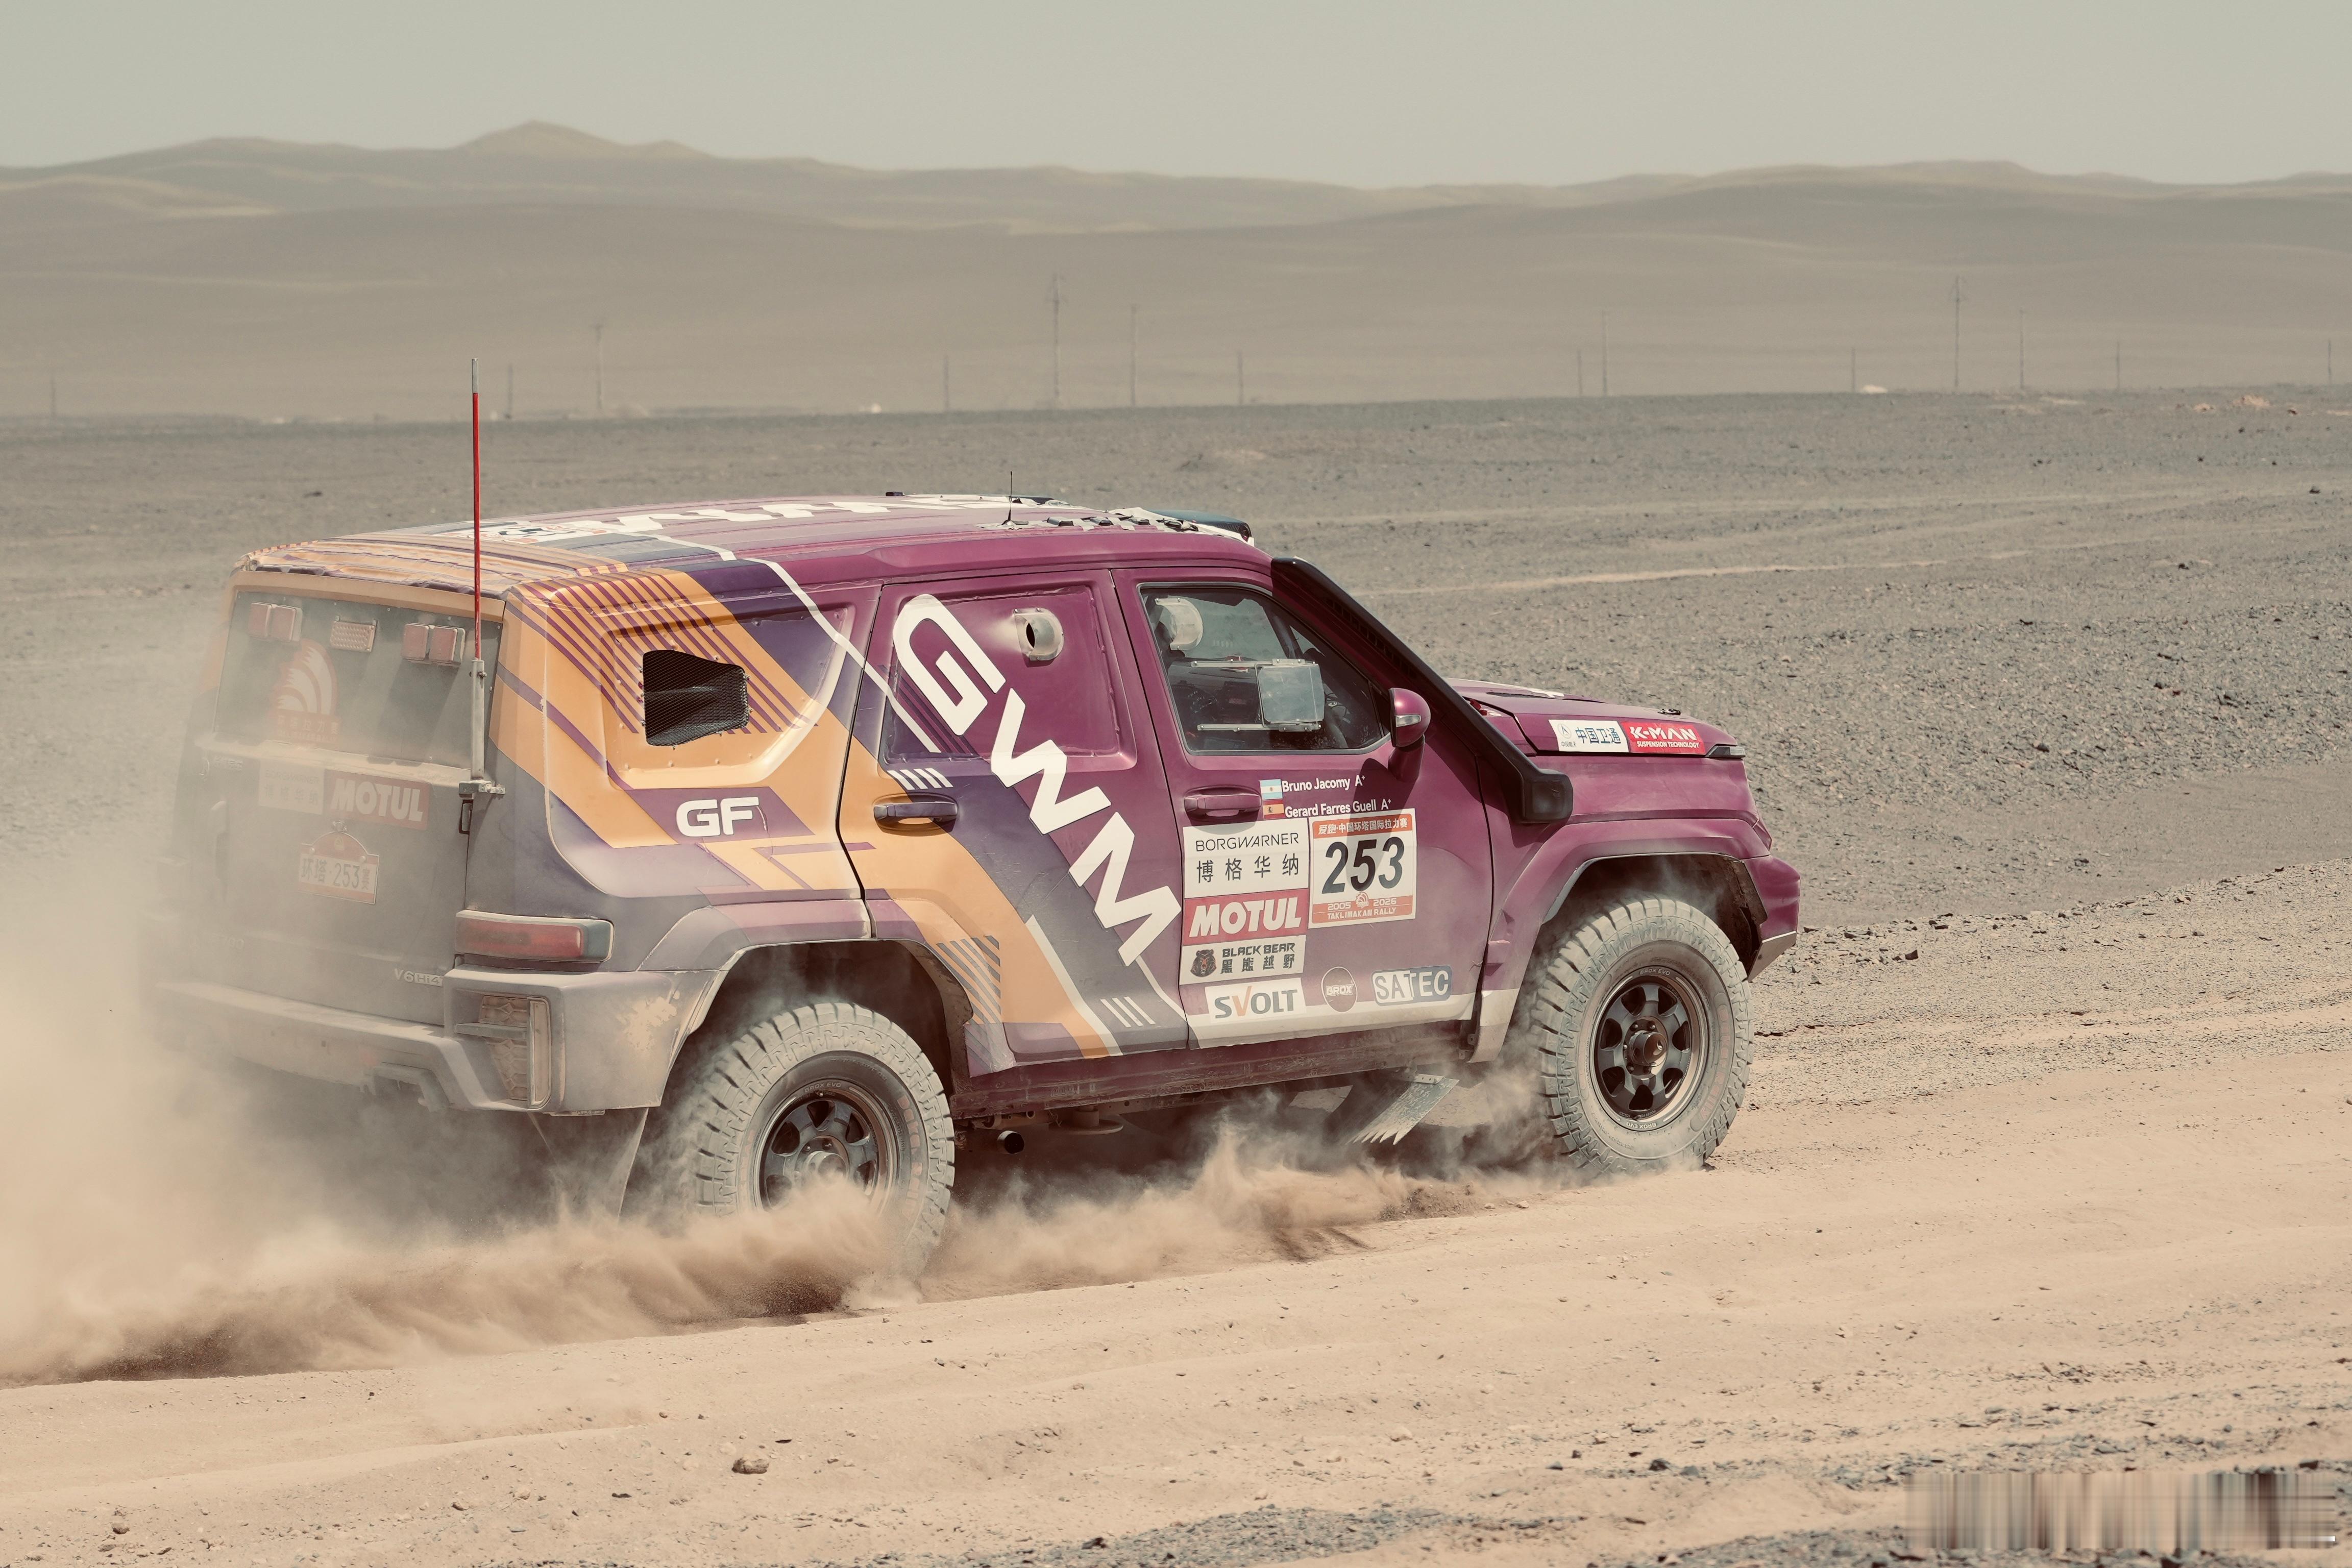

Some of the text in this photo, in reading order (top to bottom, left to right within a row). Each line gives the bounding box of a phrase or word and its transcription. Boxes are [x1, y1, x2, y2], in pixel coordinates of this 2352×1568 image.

[1575, 727, 1622, 744] 中国卫通
[1630, 726, 1698, 741] K-MAN
[1637, 740, 1668, 748] SUSPENSION
[893, 594, 1181, 967] GWM
[1282, 780, 1312, 792] Bruno
[1314, 778, 1351, 791] Jacomy
[330, 778, 423, 822] MOTUL
[1285, 803, 1318, 818] Gerard
[1320, 802, 1351, 815] Farres
[1353, 799, 1377, 813] Guell
[676, 796, 760, 837] GF
[1195, 832, 1299, 851] BORGWARNER
[1196, 853, 1298, 884] 博格华纳
[1321, 837, 1404, 894] 253
[1328, 902, 1352, 911] 2005
[1373, 897, 1396, 906] 2026
[1189, 897, 1302, 938] MOTUL
[1328, 907, 1396, 920] TAKLIMAKAN RALLY
[1222, 943, 1295, 958] BLACK BEAR
[394, 968, 414, 983] V6
[1327, 984, 1354, 997] BROX
[1375, 970, 1449, 1000] SATEC
[1214, 986, 1298, 1019] SVOLT
[804, 1083, 825, 1093] BROX
